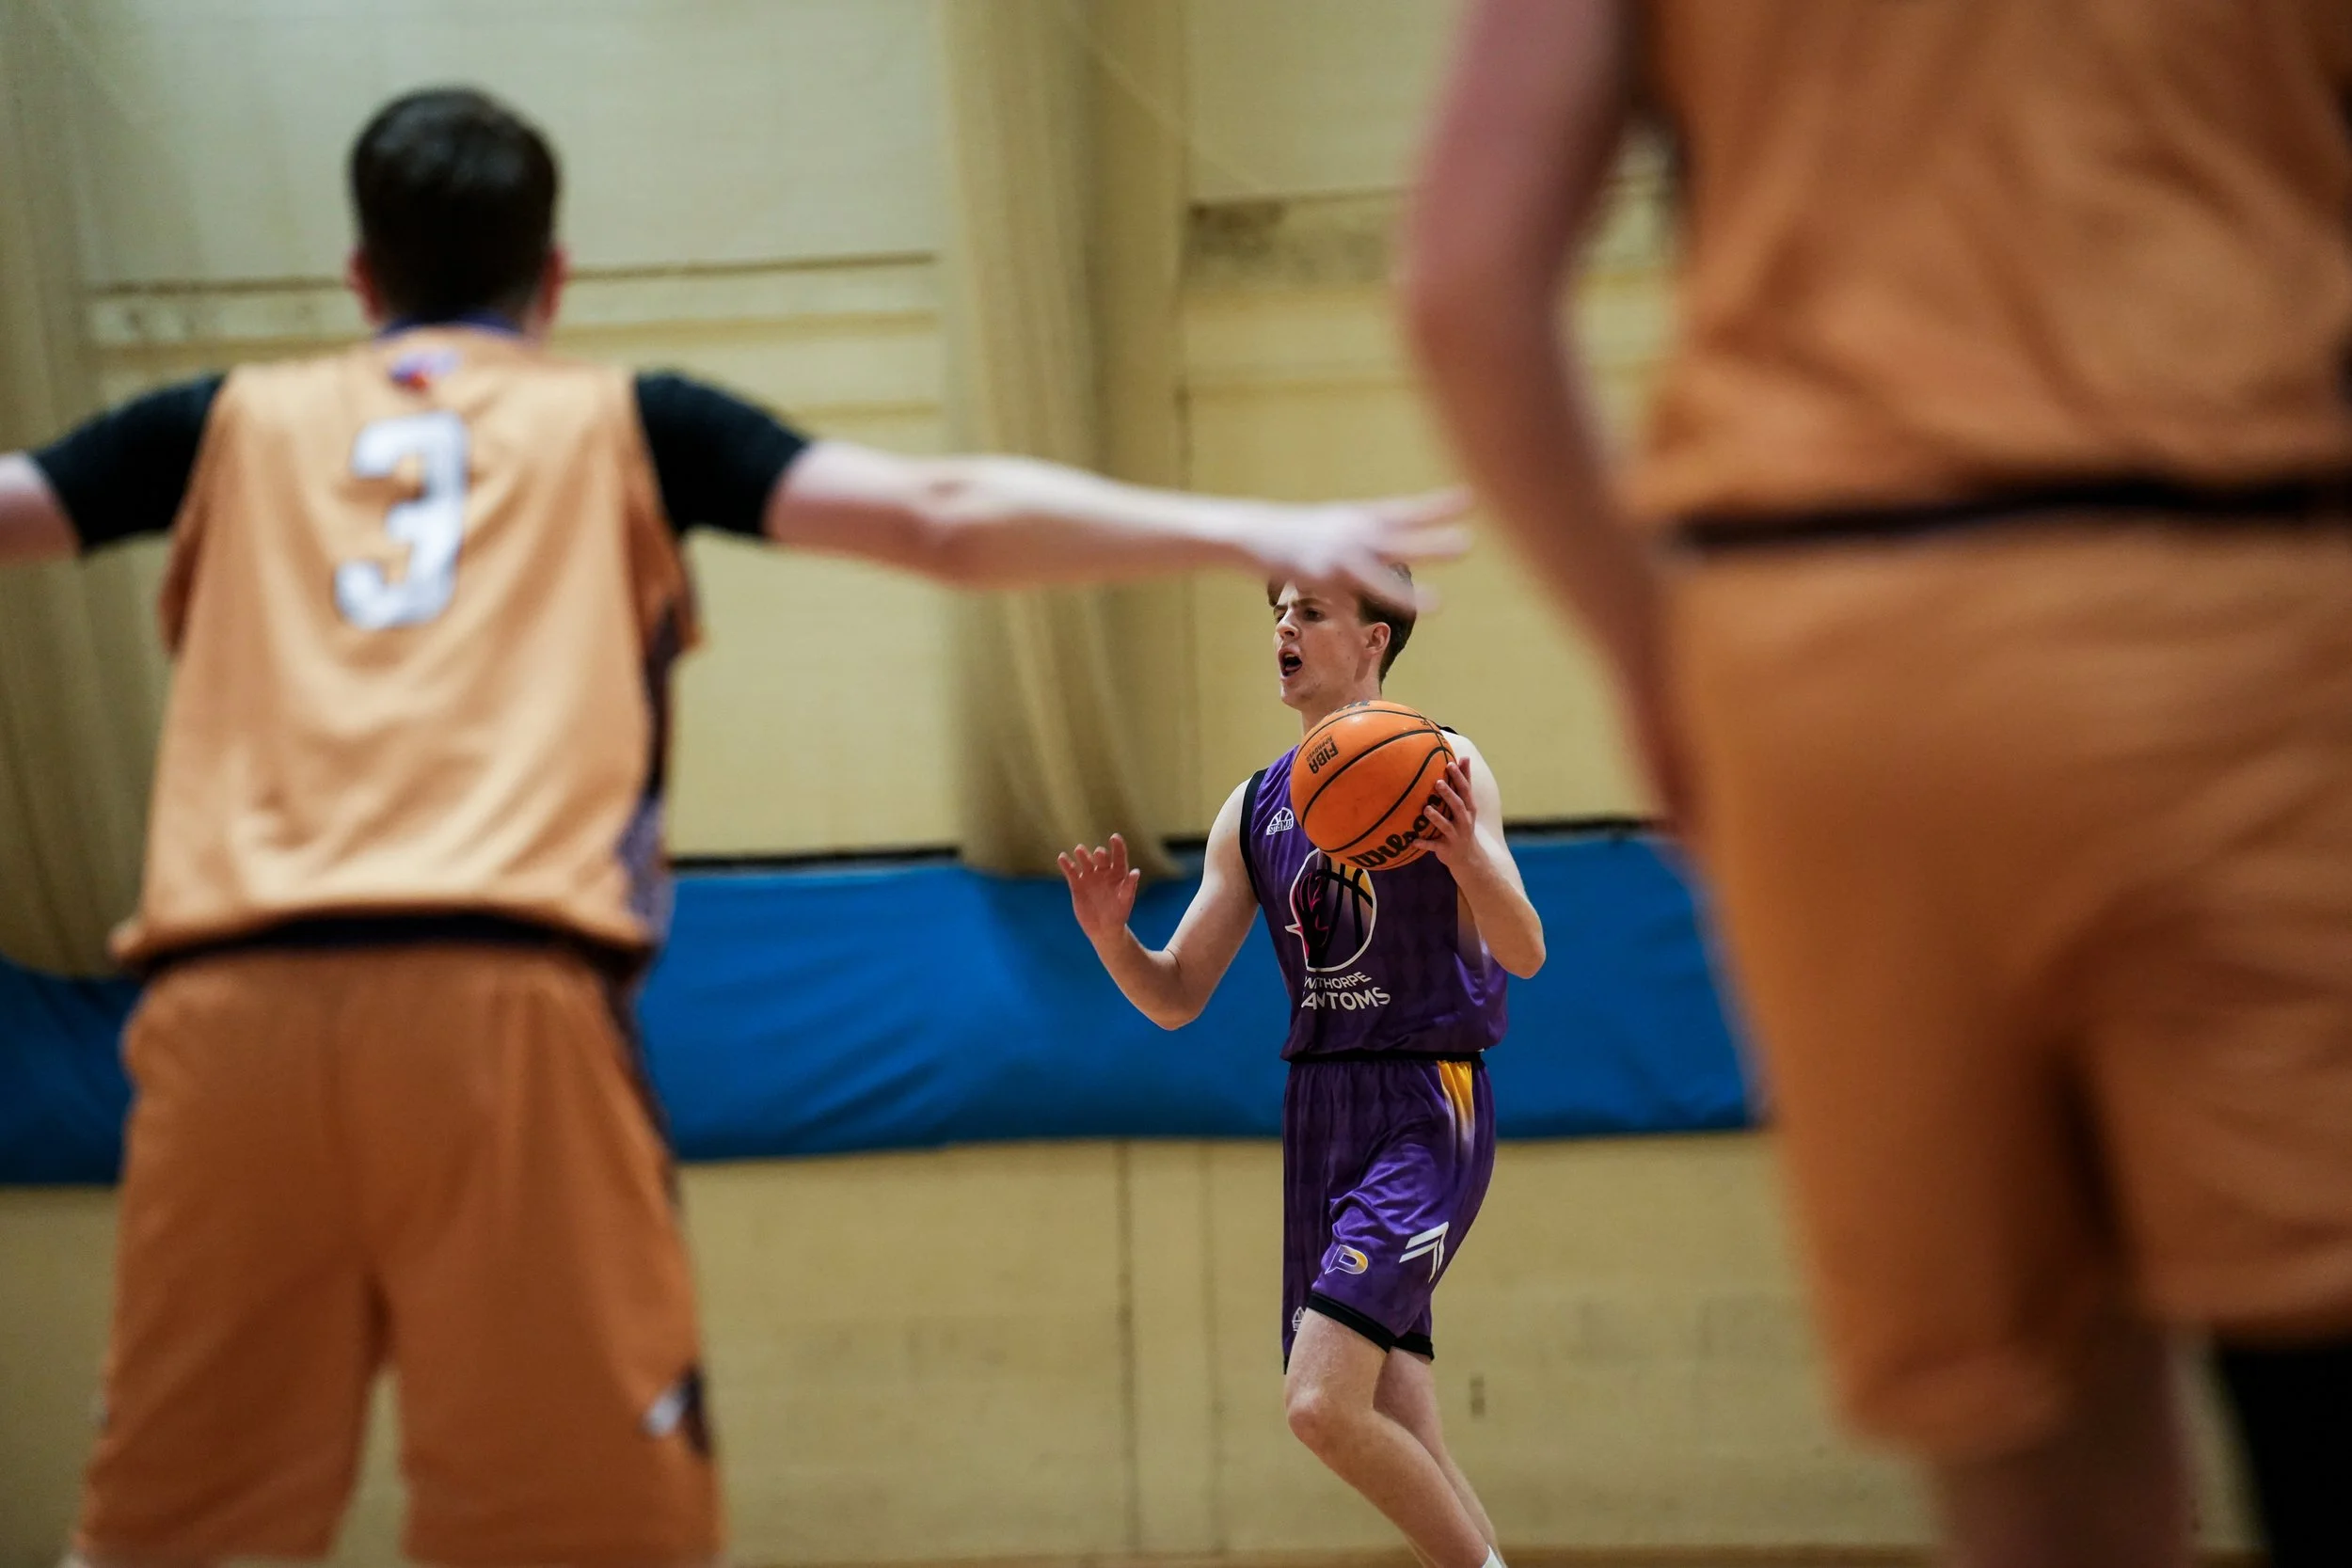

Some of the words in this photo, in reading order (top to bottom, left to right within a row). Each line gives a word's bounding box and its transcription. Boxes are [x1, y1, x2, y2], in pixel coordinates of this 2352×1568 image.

[335, 411, 466, 629] 3
[1309, 742, 1339, 774] FIBA
[1304, 971, 1373, 990] NTHORPE
[1301, 987, 1391, 1011] ANTOMS
[1325, 1244, 1369, 1275] P
